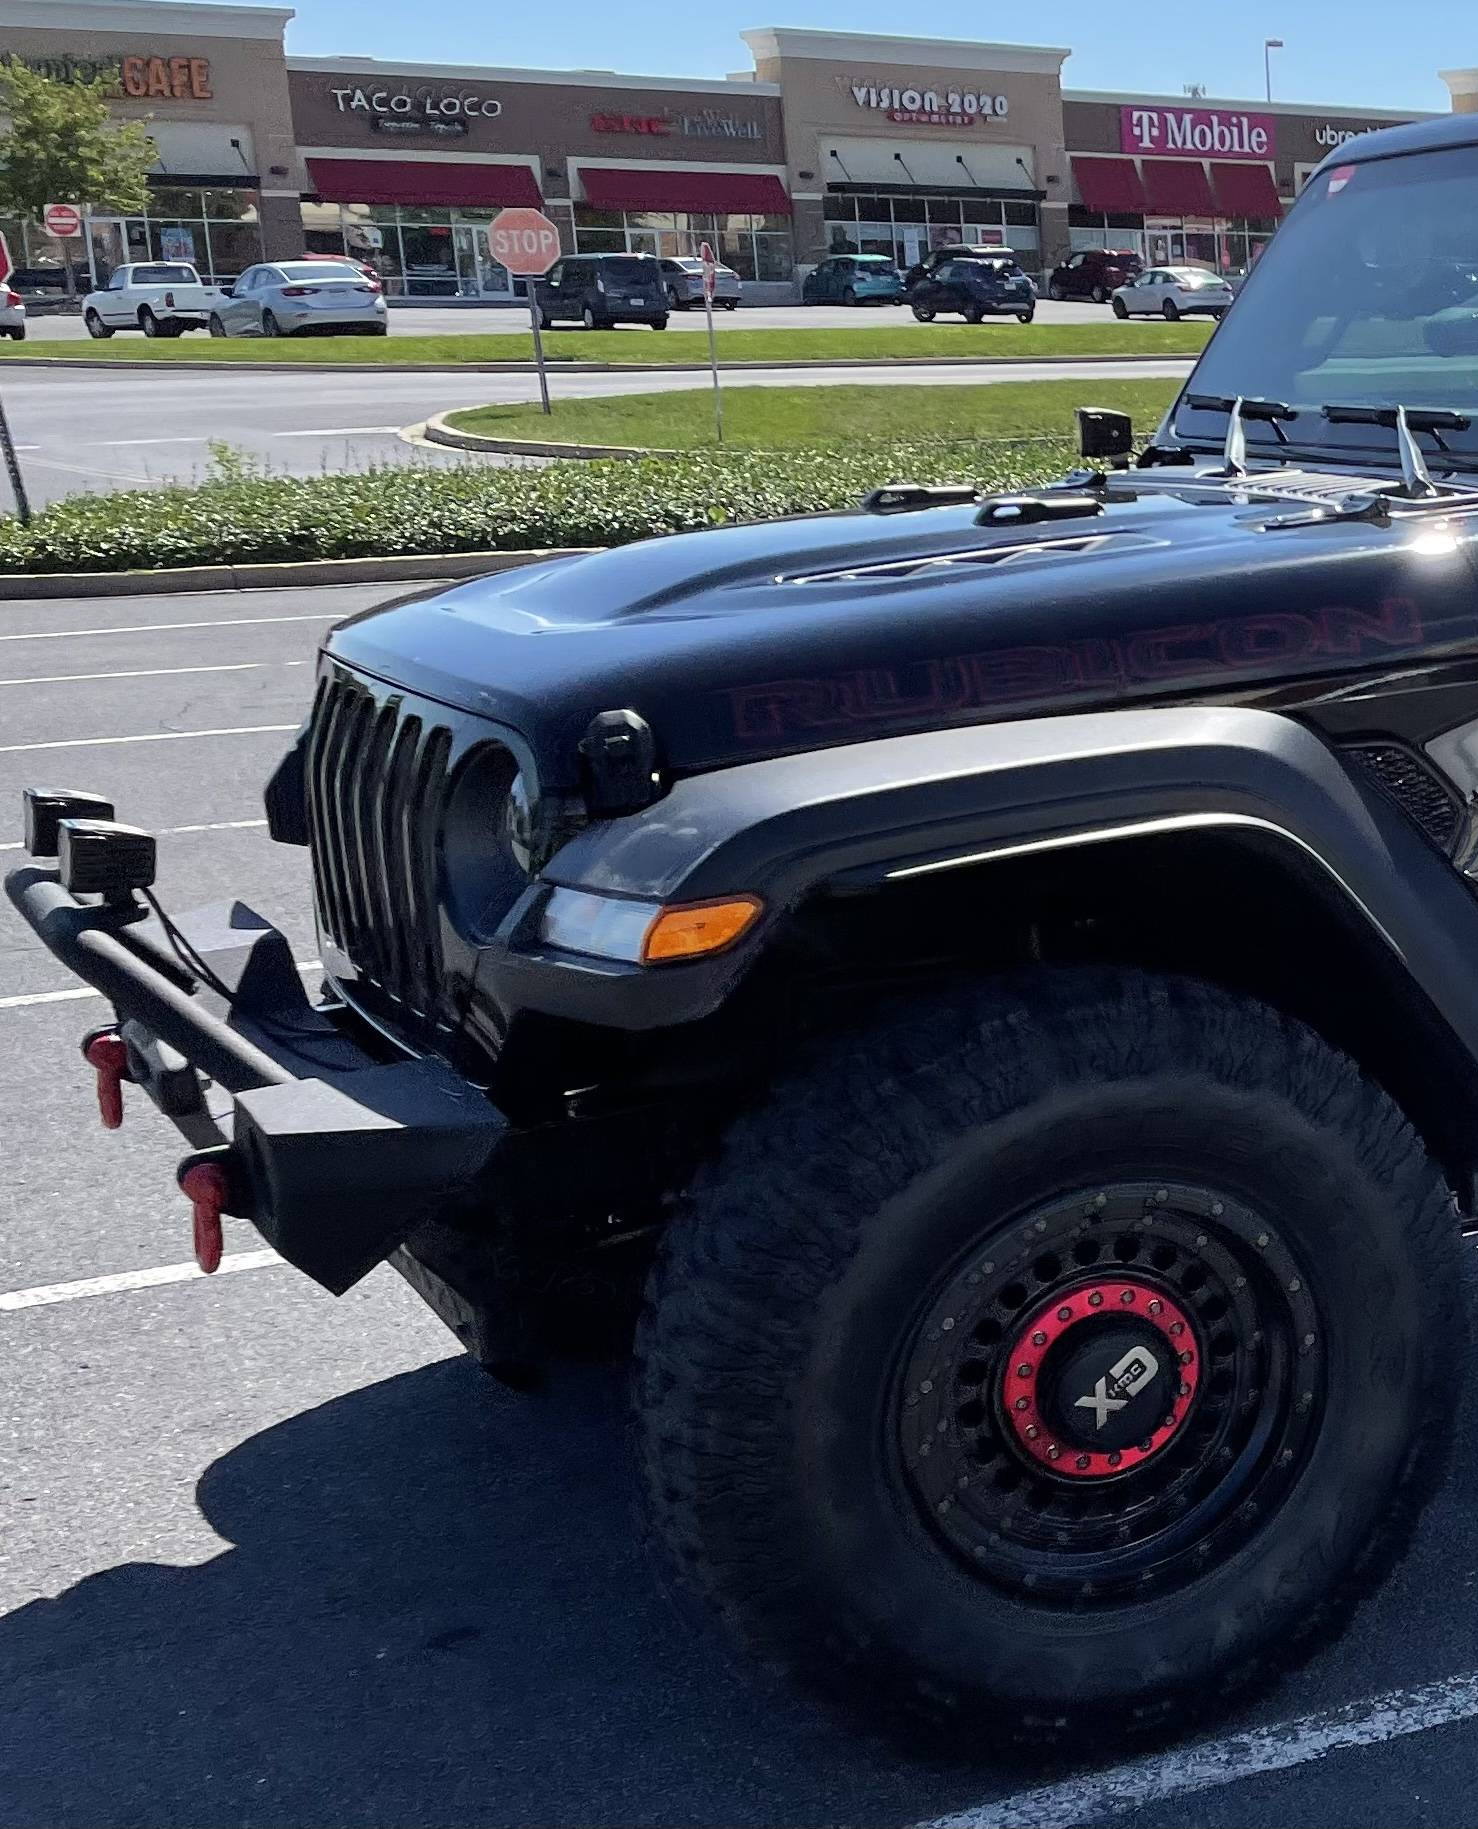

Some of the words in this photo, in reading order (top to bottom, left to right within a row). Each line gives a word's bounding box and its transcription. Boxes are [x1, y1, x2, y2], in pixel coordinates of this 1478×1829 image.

[122, 54, 213, 99] CAFE
[330, 88, 412, 113] TACO
[425, 95, 501, 118] LOCO
[851, 86, 939, 113] VISION
[947, 92, 1009, 115] 2020
[494, 229, 553, 255] STOP
[731, 597, 1424, 741] RUBICON
[1074, 1346, 1159, 1430] XD
